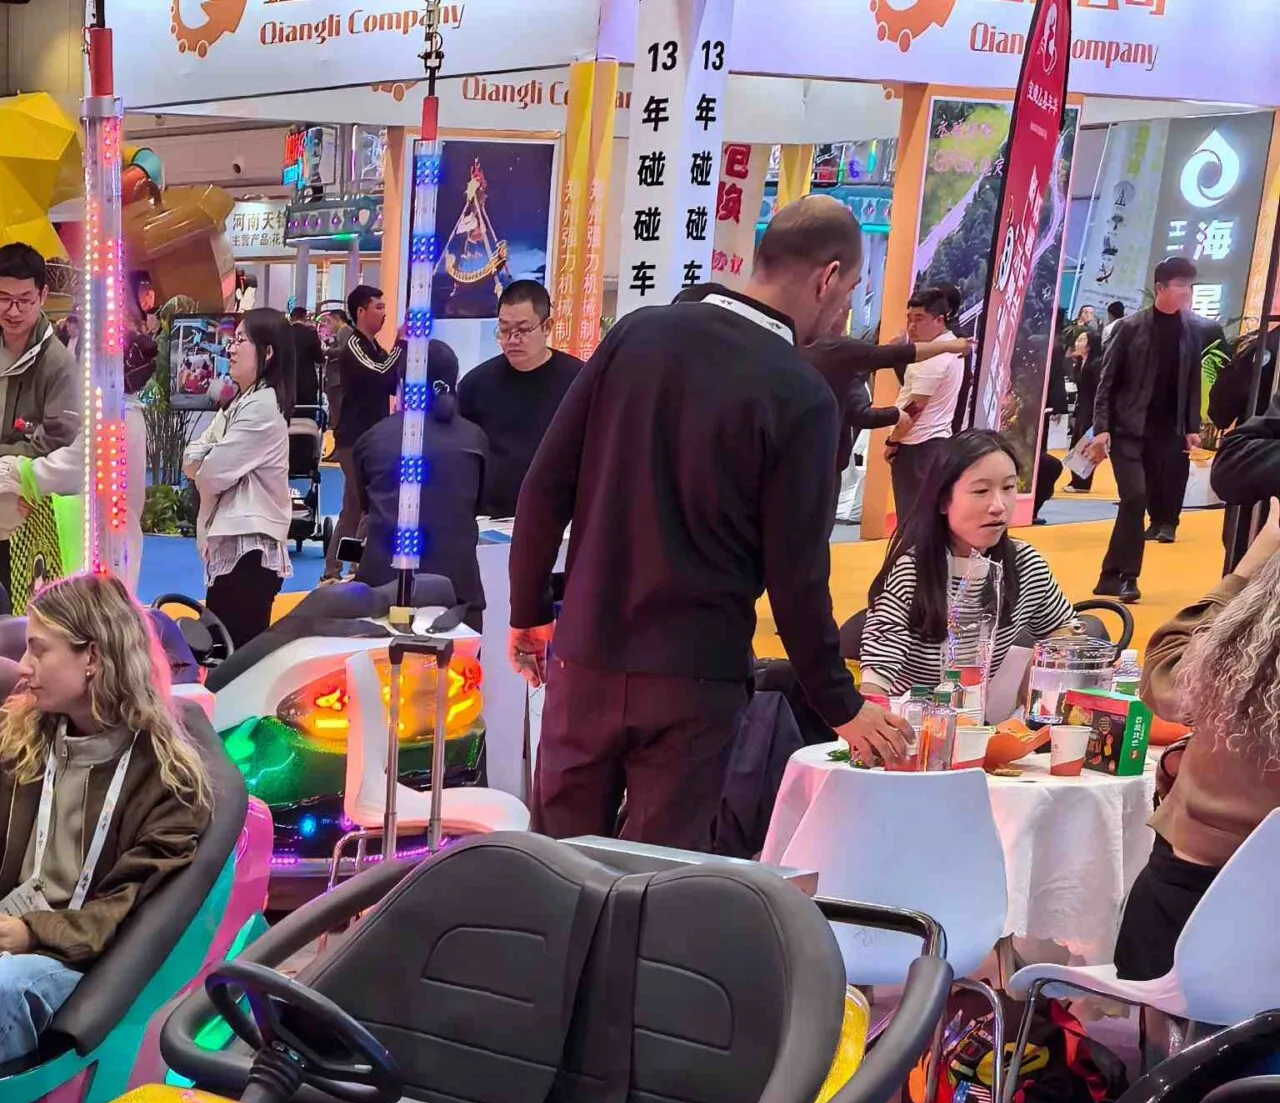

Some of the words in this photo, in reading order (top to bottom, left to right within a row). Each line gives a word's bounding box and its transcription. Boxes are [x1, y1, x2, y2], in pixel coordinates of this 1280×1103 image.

[259, 14, 341, 46] Qiangli
[969, 21, 1023, 55] Qian
[1071, 37, 1159, 71] ompany
[462, 75, 542, 109] Qiangli
[630, 40, 679, 296] 13年碰碰车
[681, 40, 725, 288] 13年碰碰车
